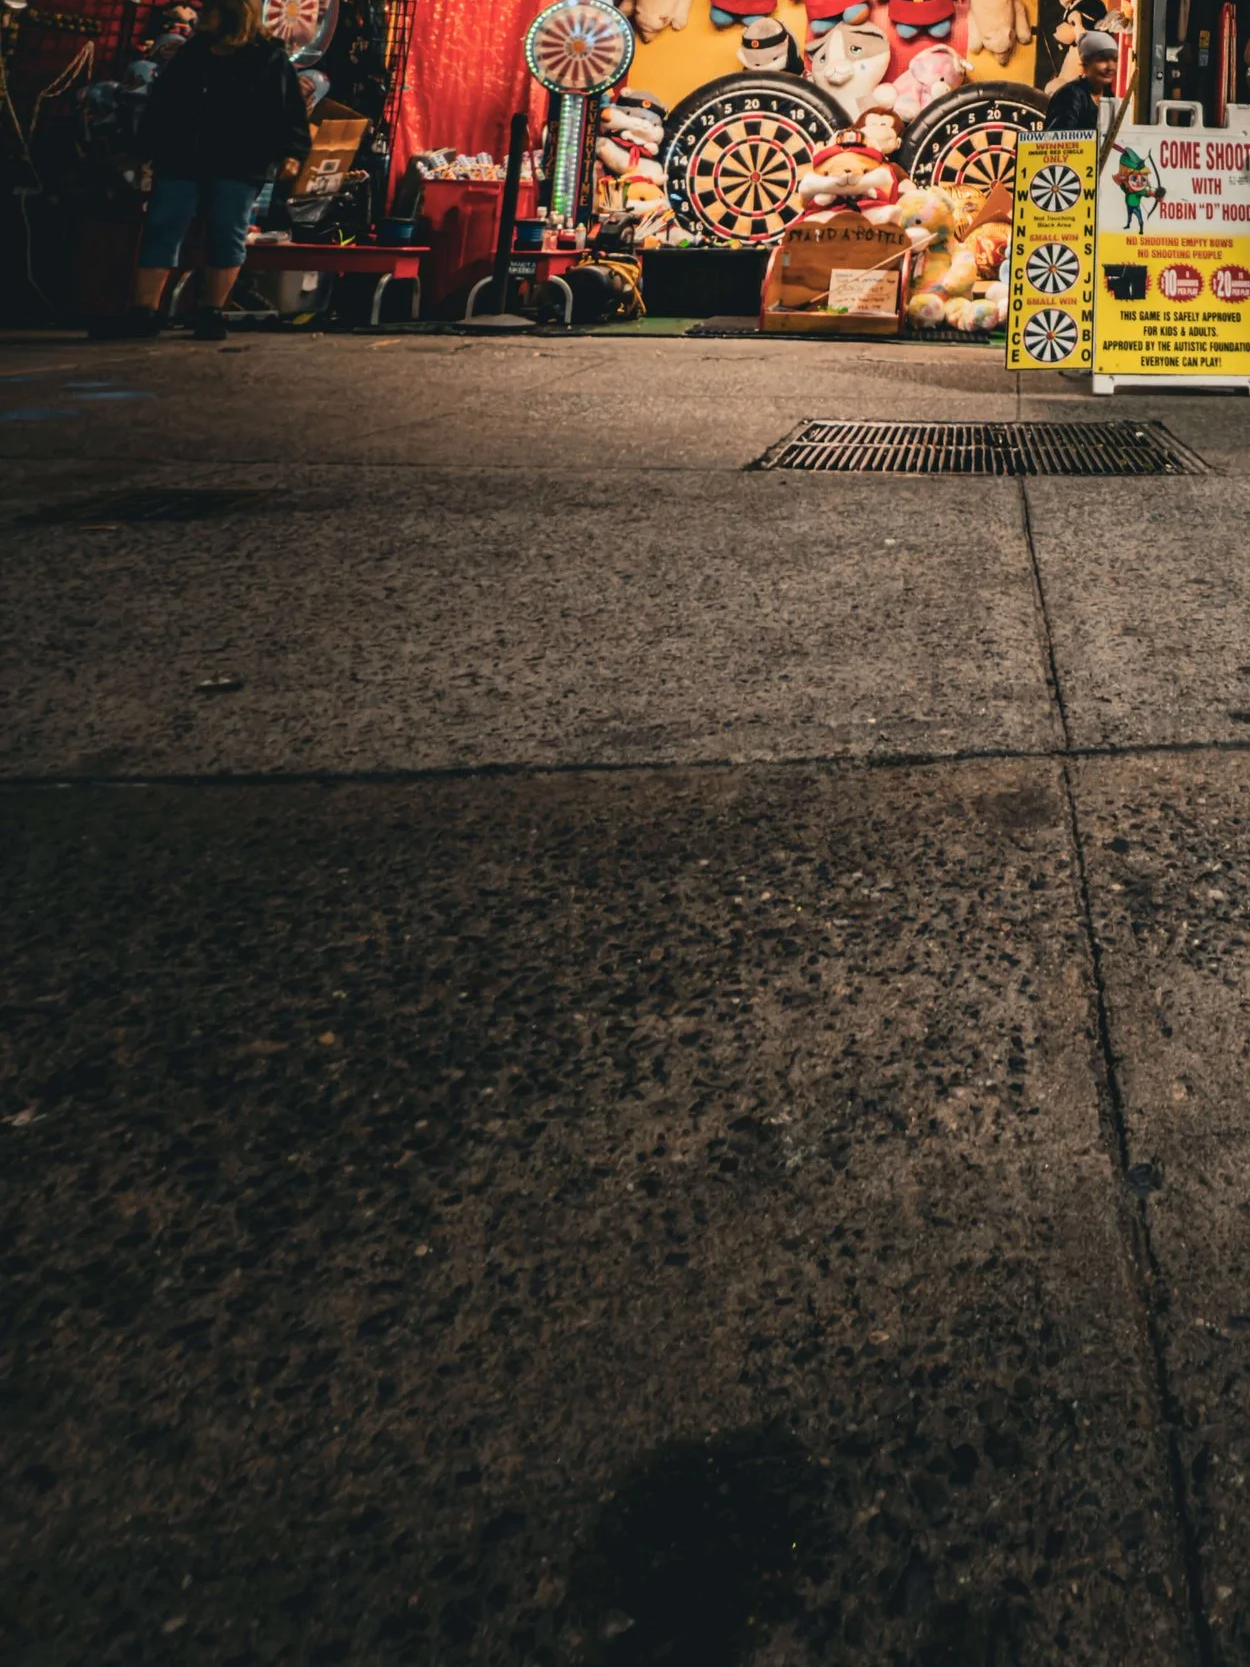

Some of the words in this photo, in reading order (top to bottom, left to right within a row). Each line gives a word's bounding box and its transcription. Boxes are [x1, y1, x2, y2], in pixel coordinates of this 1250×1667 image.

[724, 103, 732, 114] 5
[744, 98, 760, 110] 20
[771, 100, 777, 110] 1
[790, 109, 805, 120] 18
[701, 115, 714, 126] 12
[809, 122, 817, 133] 4
[932, 143, 939, 153] 9
[946, 123, 959, 134] 12
[968, 112, 976, 123] 5
[987, 109, 1001, 120] 20
[1012, 112, 1018, 121] 1
[1030, 121, 1044, 132] 18
[687, 134, 696, 146] 9
[1019, 132, 1044, 141] BOW
[1052, 131, 1094, 140] ARROW
[1036, 142, 1080, 150] WINNER
[579, 100, 598, 207] EVERYTIME
[1043, 155, 1068, 163] ONLY
[1160, 140, 1201, 170] COME
[1206, 142, 1250, 171] SHOOT
[673, 156, 688, 166] 14
[1021, 167, 1027, 179] 1
[1086, 166, 1093, 178] 2
[672, 179, 686, 189] 11
[1192, 177, 1222, 195] WITH
[681, 201, 689, 212] 8
[1160, 201, 1196, 220] ROBIN
[1029, 234, 1059, 242] SMALL
[1126, 237, 1137, 246] NO
[1140, 237, 1179, 246] SHOOTING
[1181, 237, 1207, 247] EMPTY
[1210, 238, 1233, 248] BOWS
[1138, 249, 1148, 258] NO
[1151, 249, 1190, 259] SHOOTING
[1193, 250, 1222, 260] PEOPLE
[1060, 297, 1077, 305] WIN
[1011, 268, 1024, 362] CHOICE
[1081, 271, 1092, 362] JUMBO
[1120, 311, 1136, 321] THIS
[1139, 311, 1160, 321] GAME
[1164, 311, 1170, 321] IS
[1174, 311, 1199, 322] SAFELY
[1202, 312, 1241, 322] APPROVED
[1144, 326, 1157, 336] FOR
[1160, 326, 1177, 336] KIDS
[1180, 326, 1186, 336] &
[1189, 327, 1218, 337] ADULTS.
[1103, 341, 1143, 351] APPROVED
[1146, 341, 1155, 351] BY
[1158, 341, 1170, 351] THE
[1174, 341, 1207, 352] AUTISTIC
[1141, 356, 1179, 367] EVERYONE
[1182, 356, 1198, 367] CAN
[1200, 356, 1222, 367] PLAY!
